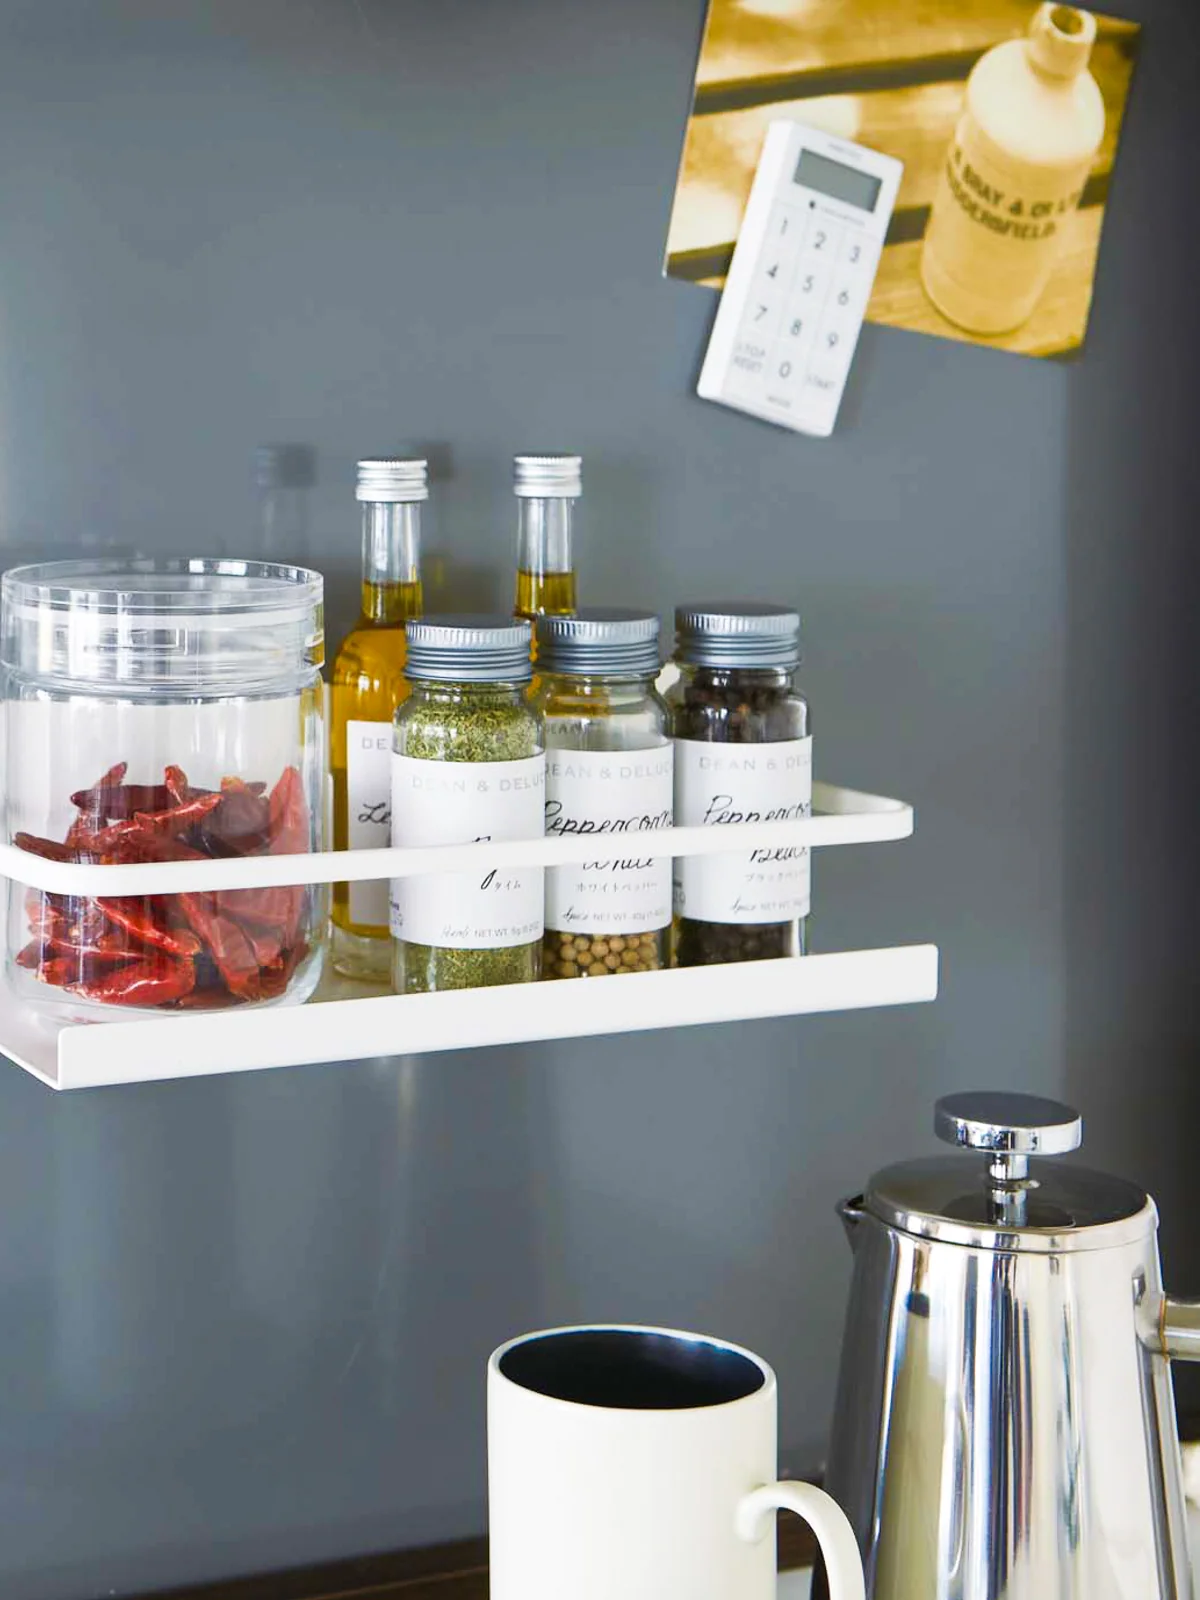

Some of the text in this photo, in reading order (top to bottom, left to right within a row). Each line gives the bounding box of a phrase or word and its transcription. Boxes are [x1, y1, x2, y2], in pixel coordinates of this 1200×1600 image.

[780, 216, 861, 263] 1 2 3
[766, 264, 849, 306] 4 5 6
[754, 305, 839, 348] 7 8 9
[778, 361, 792, 379] 0
[361, 736, 388, 750] DE
[699, 755, 756, 771] DEAN
[766, 757, 777, 771] &
[599, 767, 612, 780] &
[412, 774, 466, 793] DEAN
[476, 779, 490, 793] &
[357, 801, 392, 825] Le
